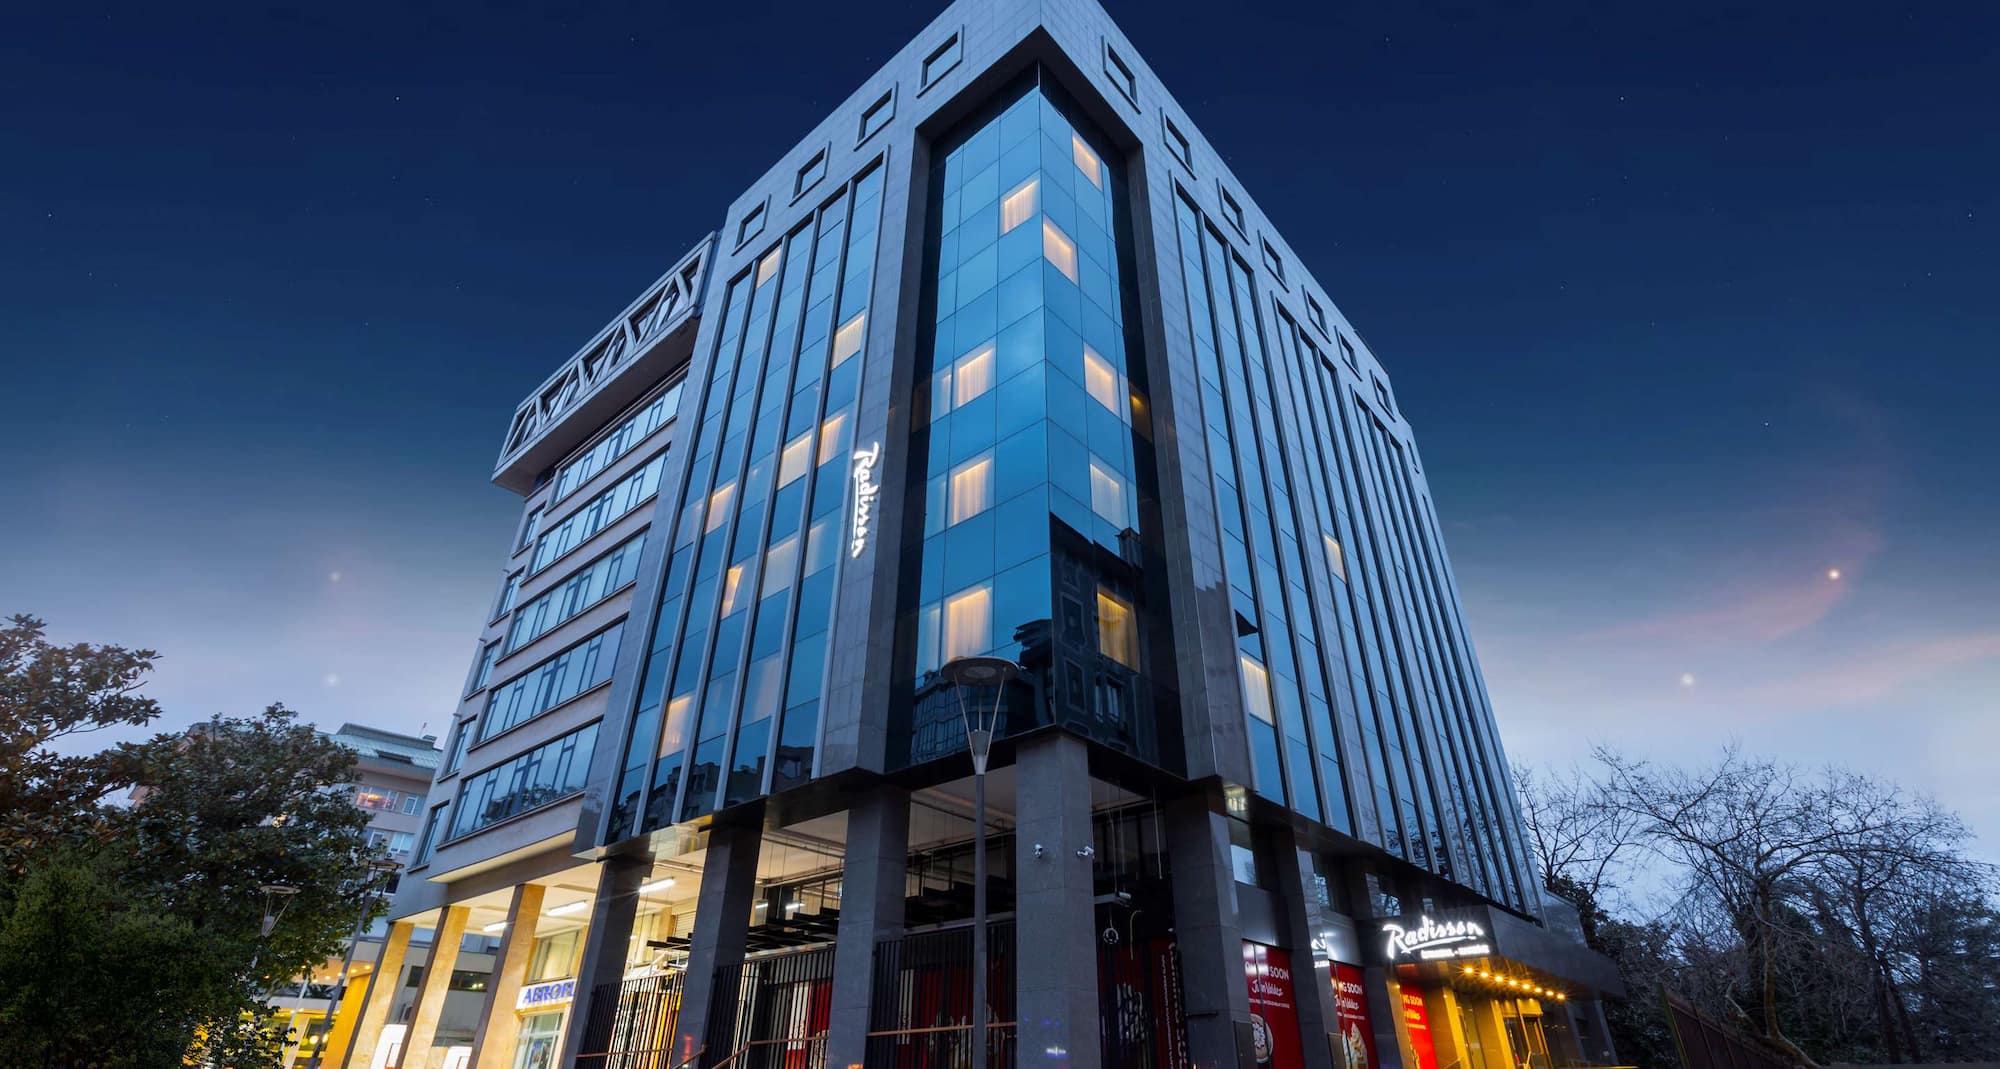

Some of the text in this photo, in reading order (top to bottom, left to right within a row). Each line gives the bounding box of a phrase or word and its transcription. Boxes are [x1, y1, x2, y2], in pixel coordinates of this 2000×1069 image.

[852, 442, 879, 558] Radisson
[1383, 915, 1484, 959] Radisson
[1270, 966, 1289, 980] SOON
